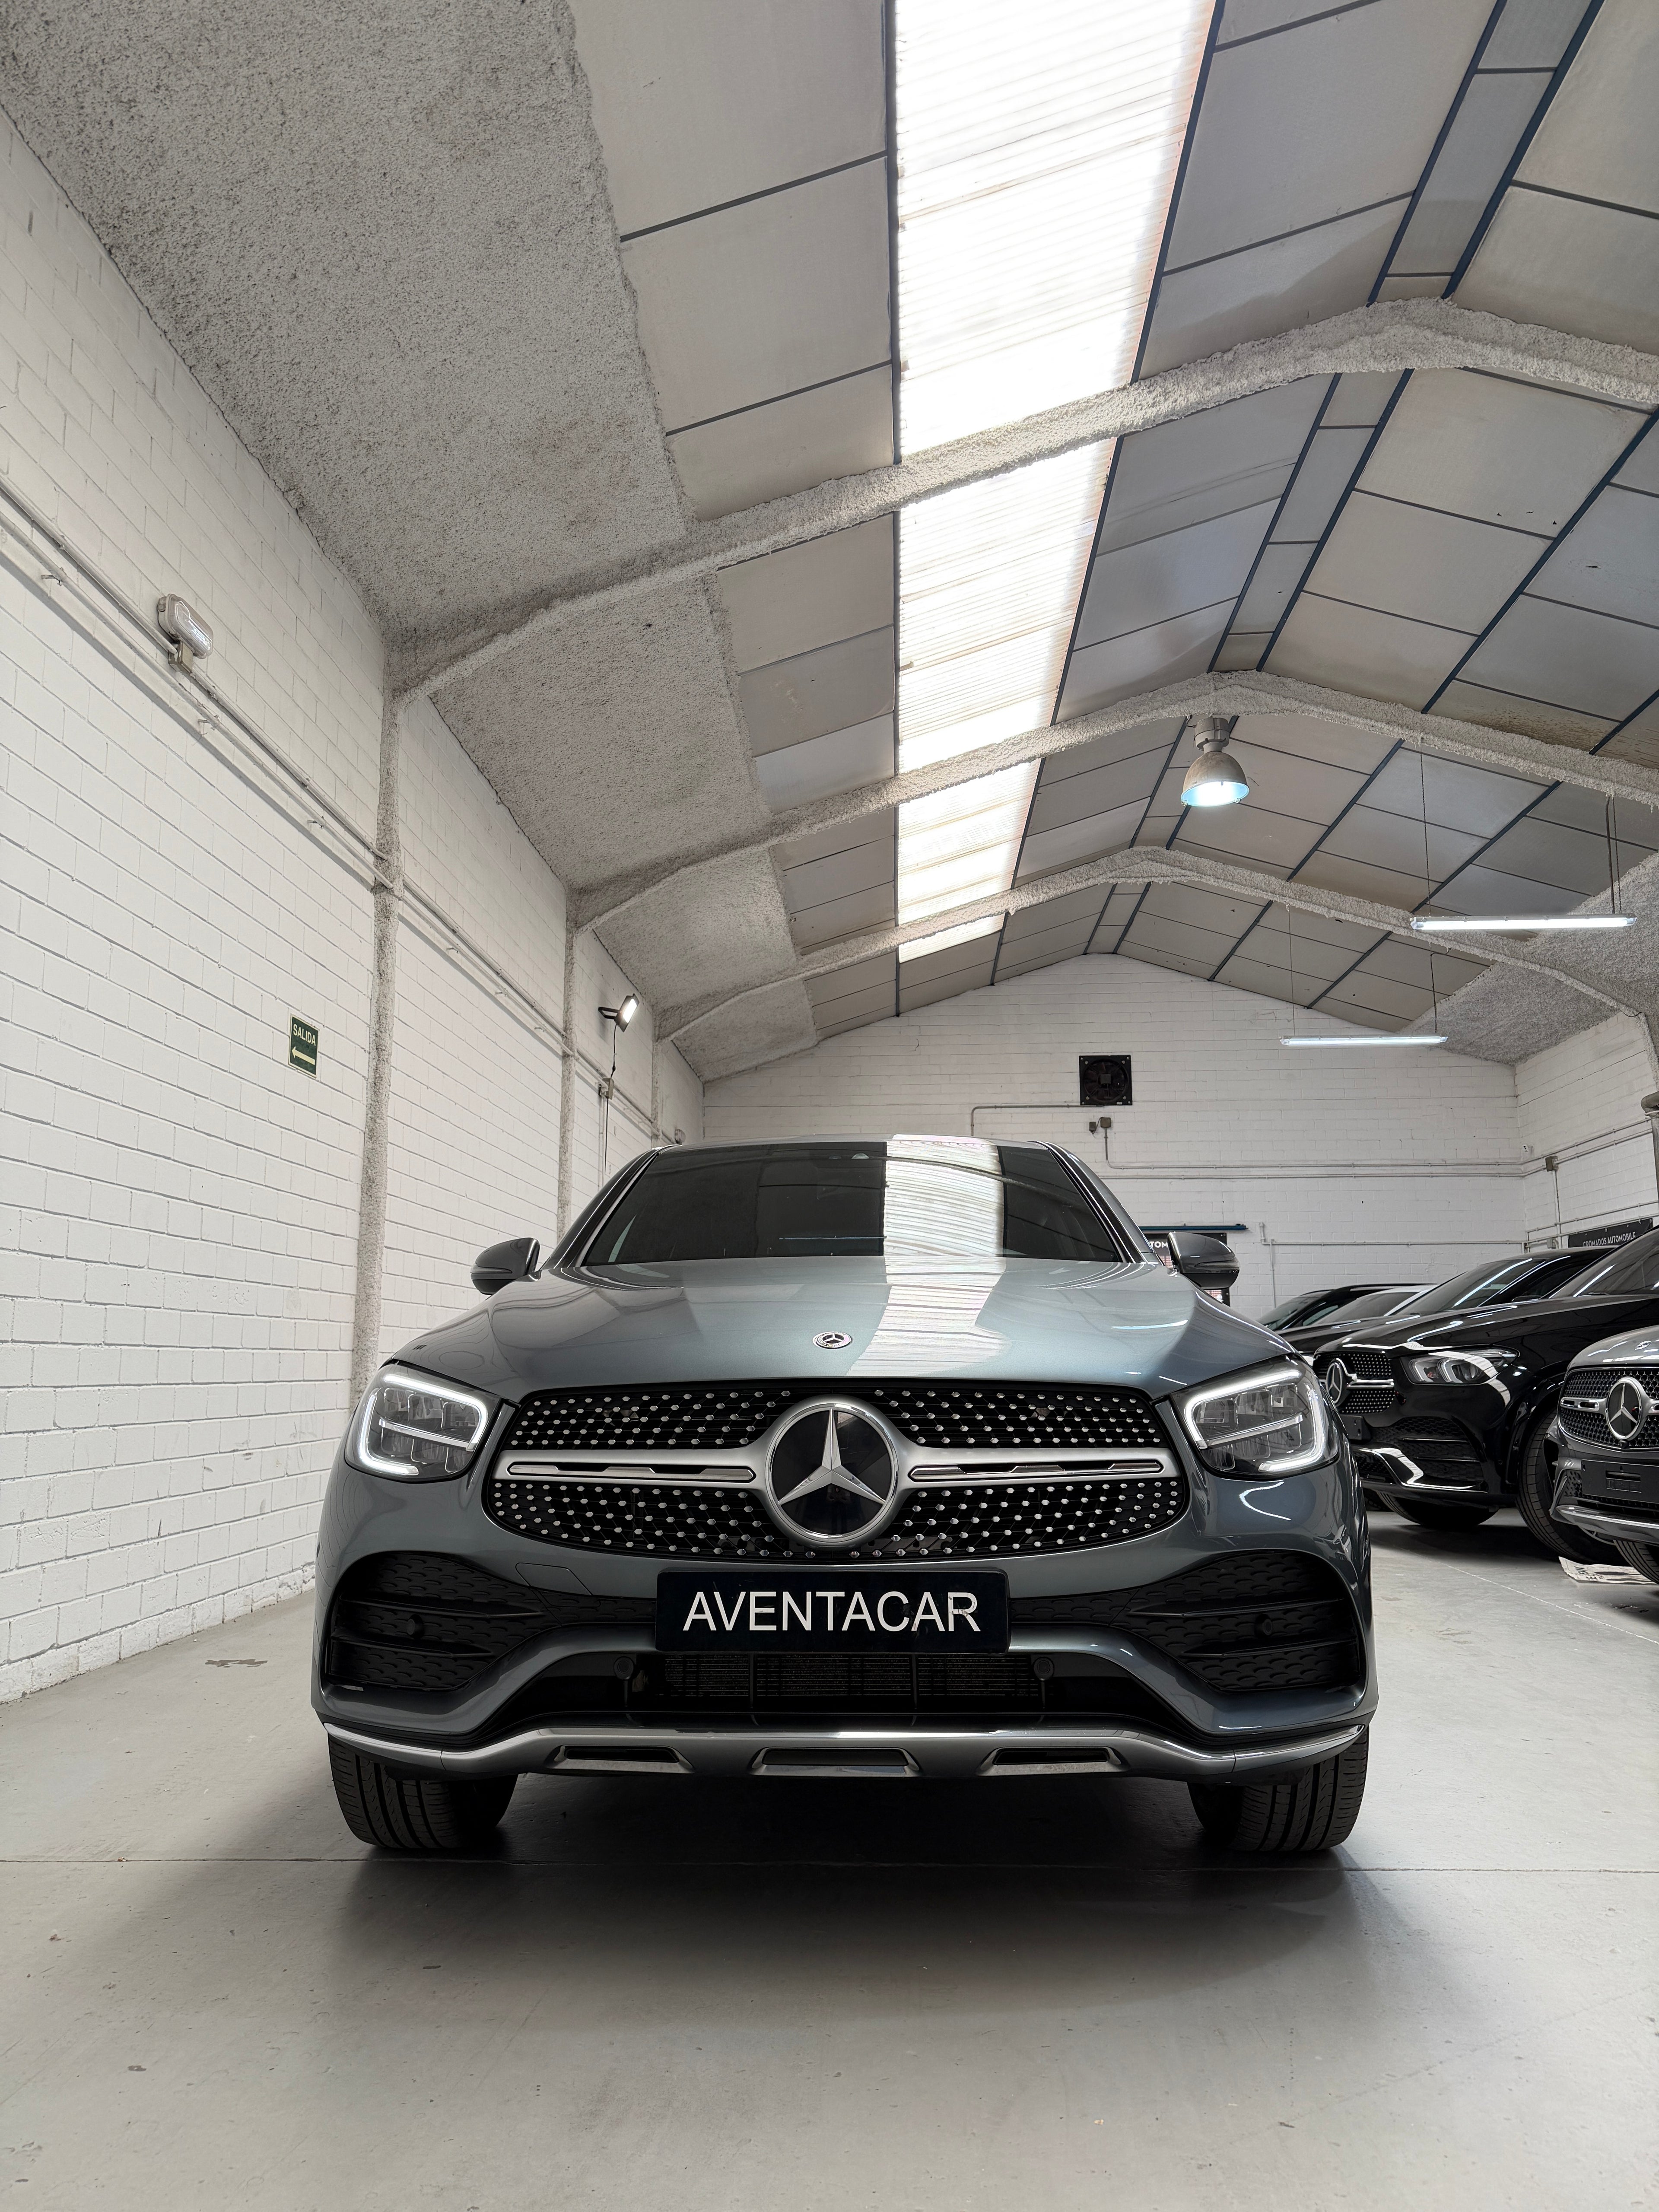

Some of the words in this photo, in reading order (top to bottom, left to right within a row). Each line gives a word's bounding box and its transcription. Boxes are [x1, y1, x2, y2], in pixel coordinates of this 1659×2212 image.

[293, 1024, 316, 1046] SALIDA
[1583, 1237, 1607, 1246] CROMADOS
[683, 1591, 981, 1632] AVENTACAR
